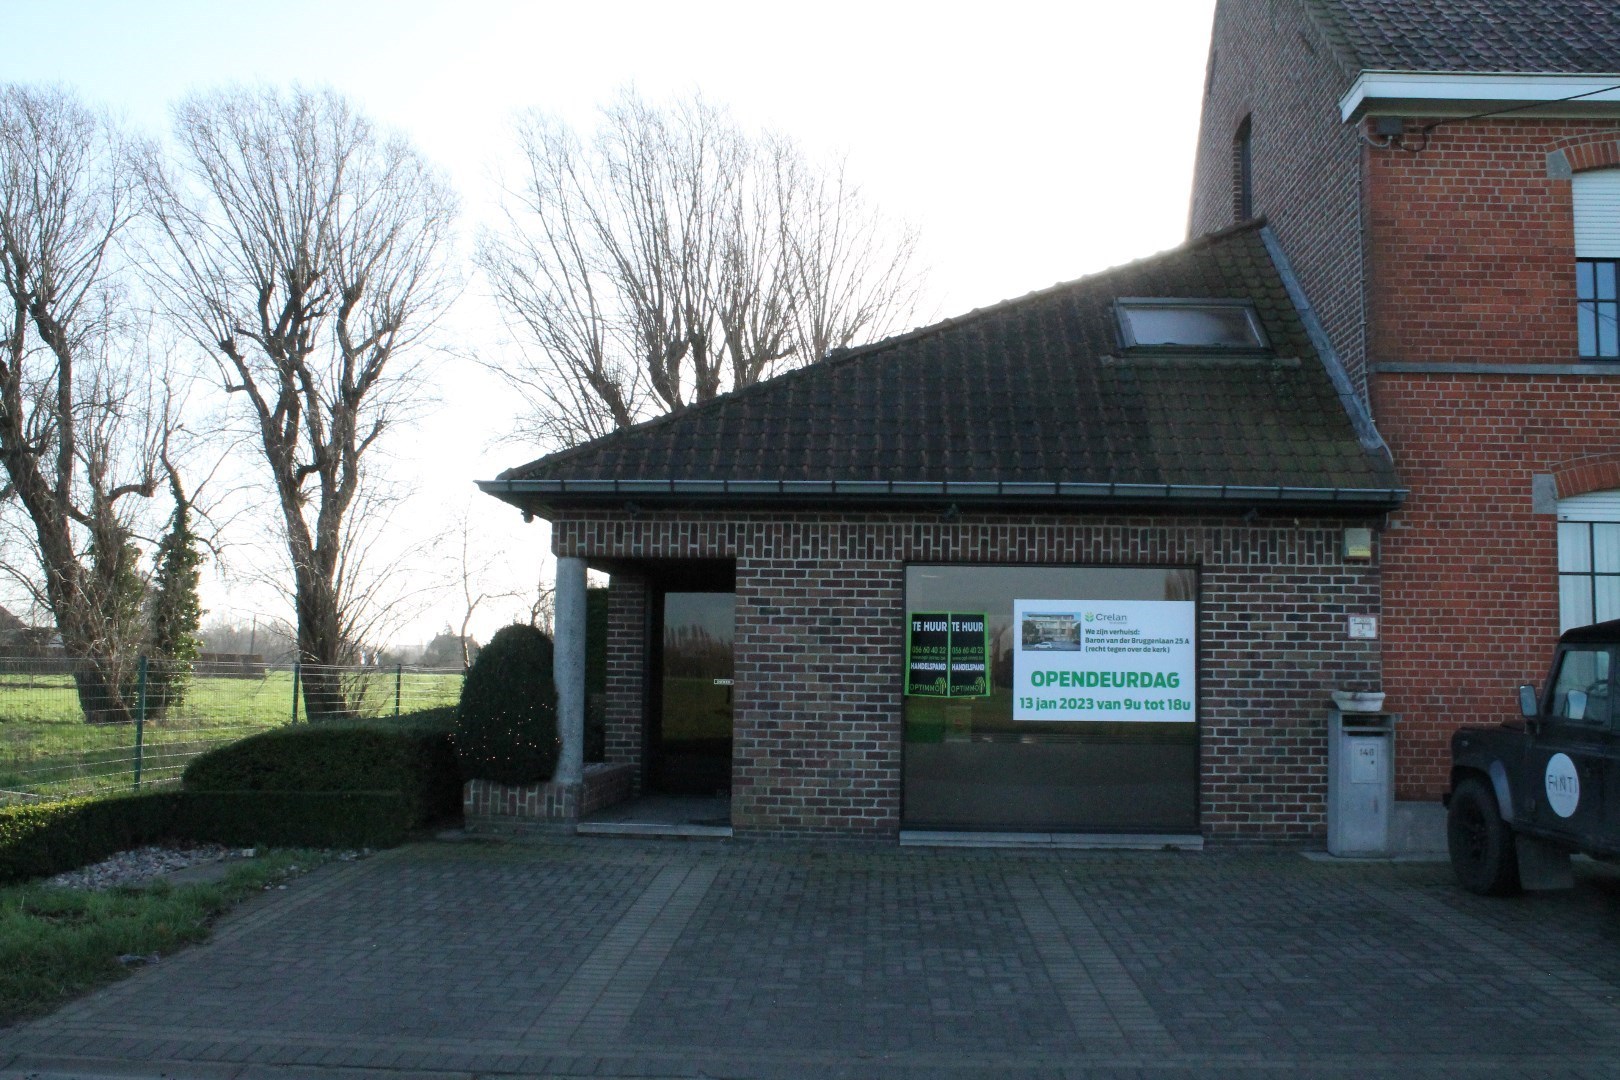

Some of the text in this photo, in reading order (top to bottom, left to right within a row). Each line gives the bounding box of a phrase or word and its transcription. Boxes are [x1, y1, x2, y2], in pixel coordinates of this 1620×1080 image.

[1096, 613, 1127, 622] Crelan
[912, 622, 947, 632] TE HUUR
[952, 622, 984, 632] TE HUUR
[911, 662, 946, 670] HANDELSPAND
[1030, 670, 1180, 688] OPENDEURDAG
[1020, 697, 1191, 711] 13 jan 2023 van 9u tot 18u
